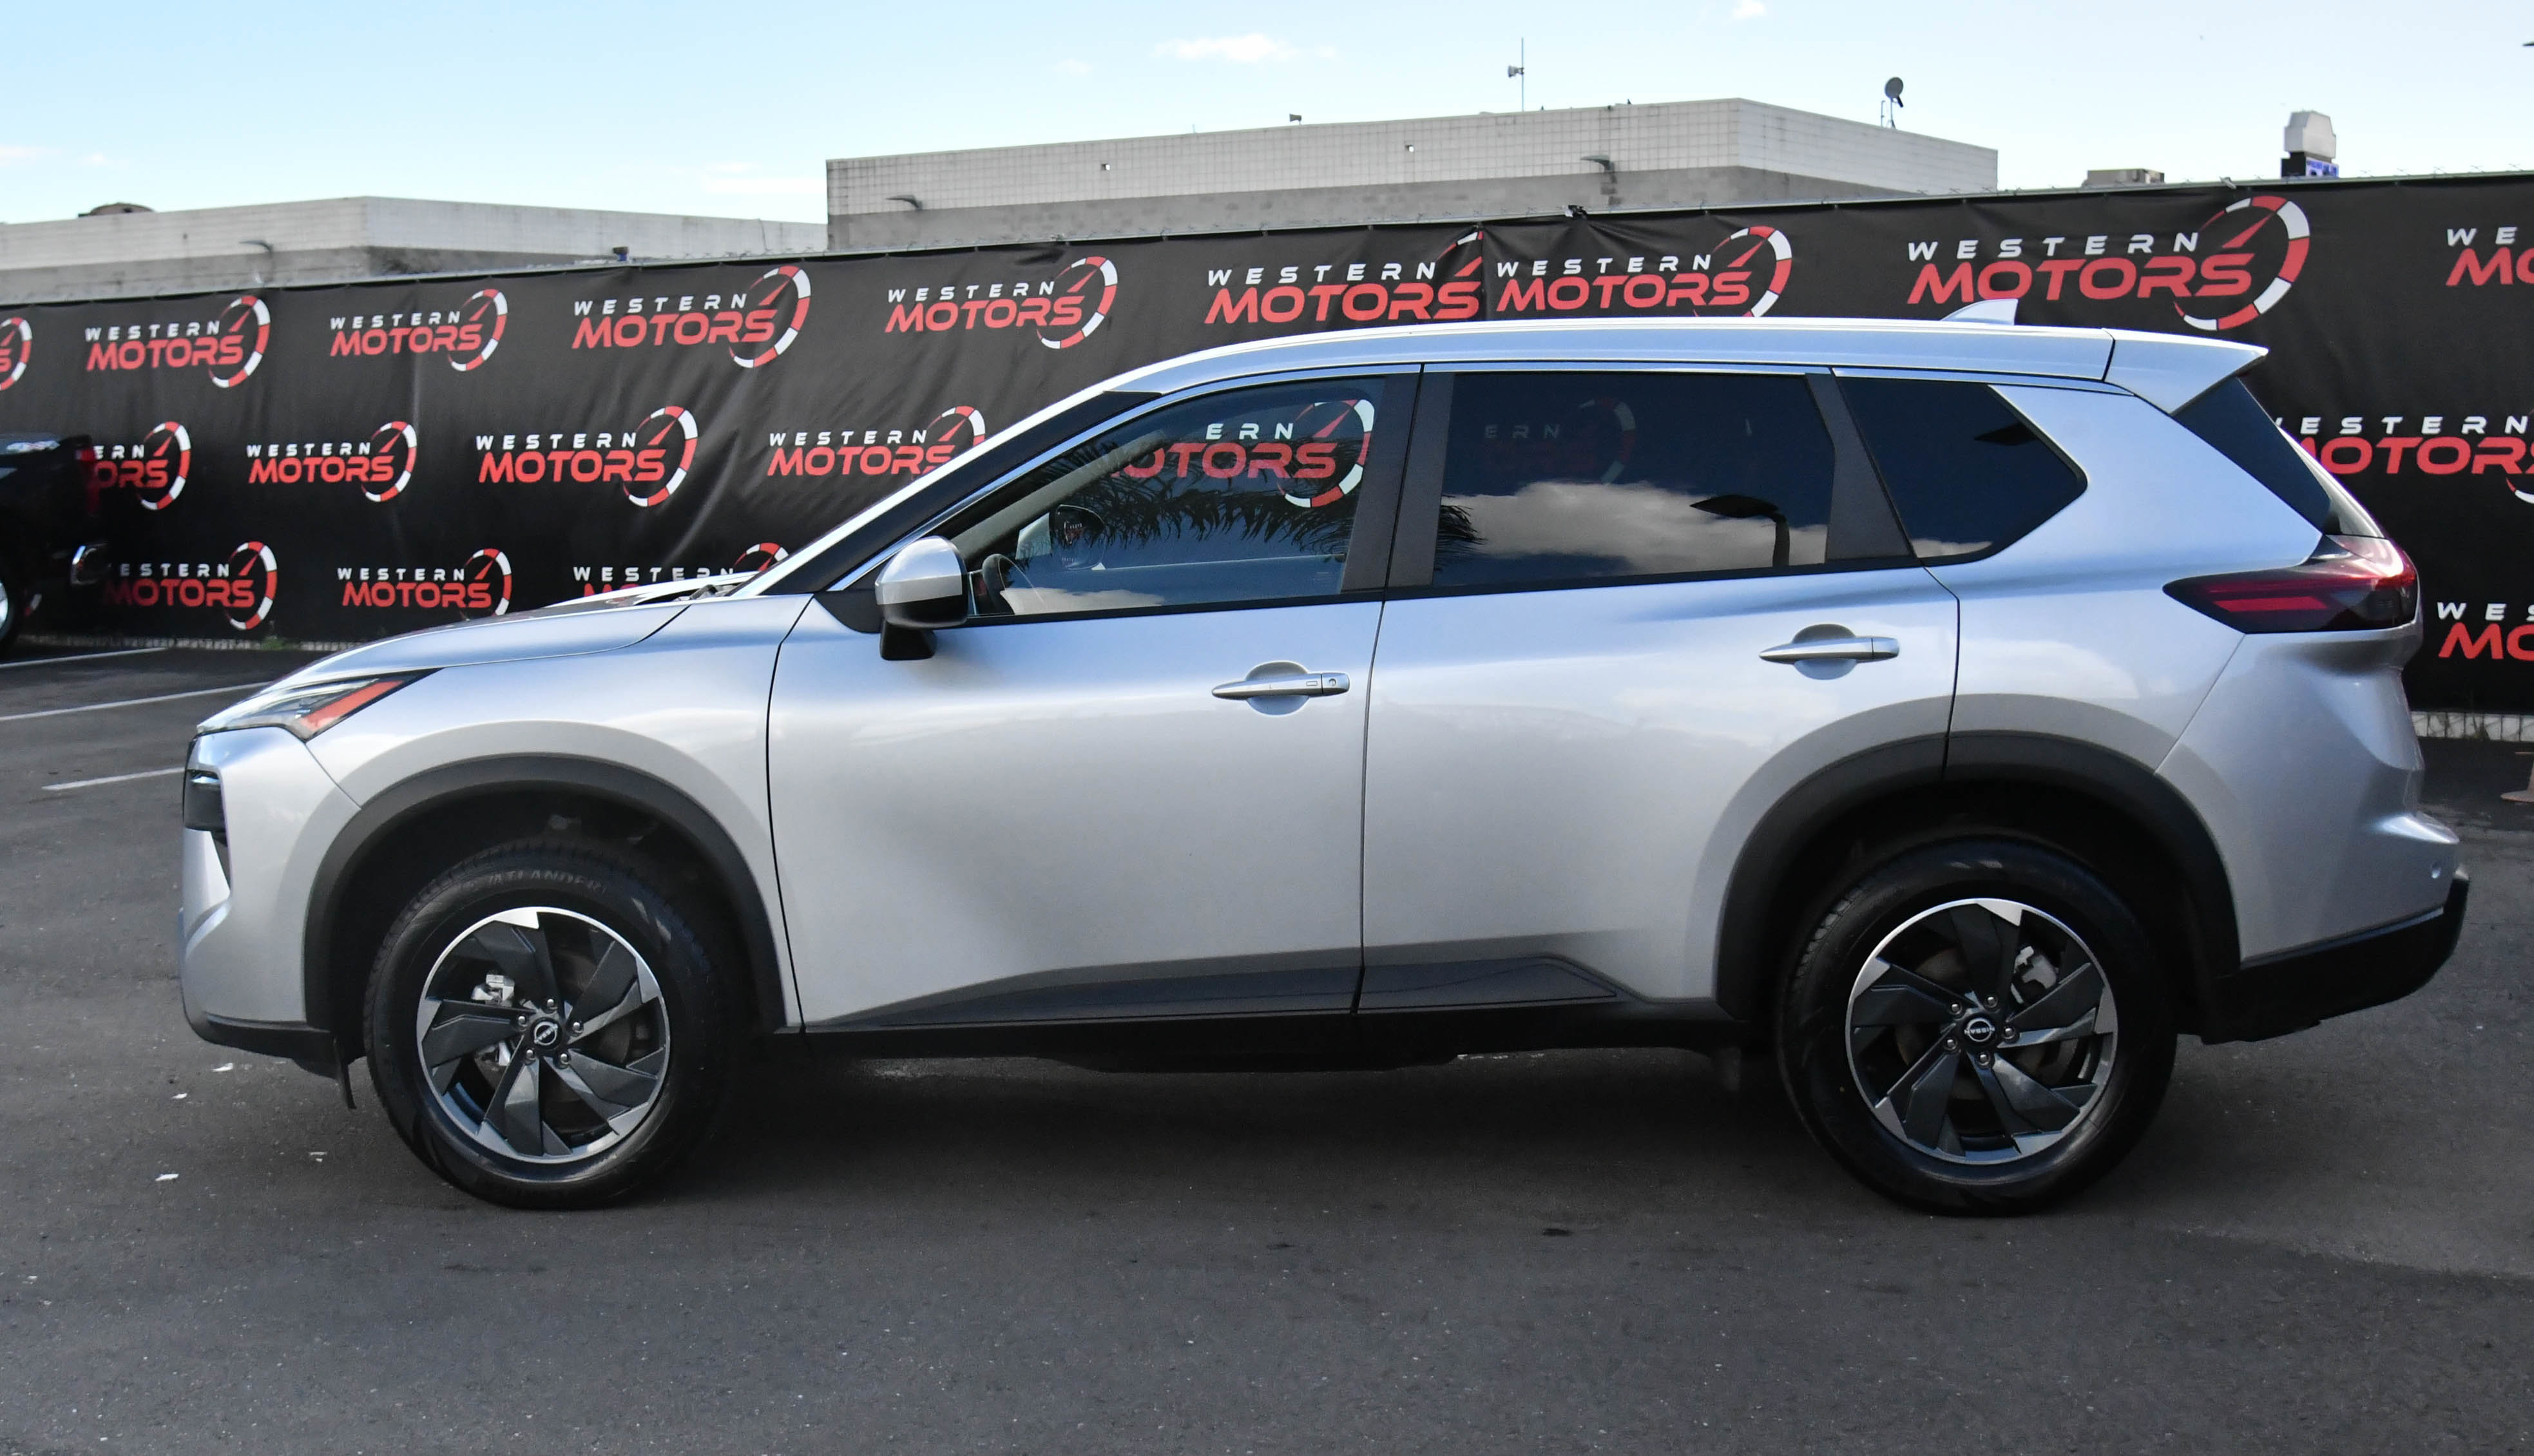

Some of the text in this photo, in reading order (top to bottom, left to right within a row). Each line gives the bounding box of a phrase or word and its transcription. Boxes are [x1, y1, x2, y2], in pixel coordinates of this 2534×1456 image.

[1908, 232, 2198, 261] WESTERN
[1208, 262, 1435, 288] WESTERN
[1497, 254, 1711, 278] WESTERN
[1907, 252, 2255, 305] MOTORS
[574, 293, 747, 316] WESTERN
[888, 281, 1055, 303] WESTERN
[1204, 281, 1481, 324] MOTORS
[1497, 271, 1752, 313] MOTORS
[330, 311, 461, 331] WESTERN
[885, 295, 1084, 334] MOTORS
[85, 320, 220, 341] WESTERN
[330, 323, 483, 357] MOTORS
[571, 309, 778, 350] MOTORS
[86, 334, 244, 372] MOTORS
[769, 429, 927, 447] WESTERN
[2275, 416, 2528, 435] ESTERN
[246, 442, 370, 457] WESTERN
[476, 432, 637, 450] WESTERN
[478, 448, 667, 484] MOTORS
[1111, 443, 1336, 478] OTORS
[2301, 436, 2534, 475] OTOR
[95, 460, 168, 488] ORS
[248, 455, 394, 484] MOTORS
[120, 563, 230, 577] ESTERN
[338, 568, 465, 581] WESTERN
[342, 582, 492, 609] MOTORS
